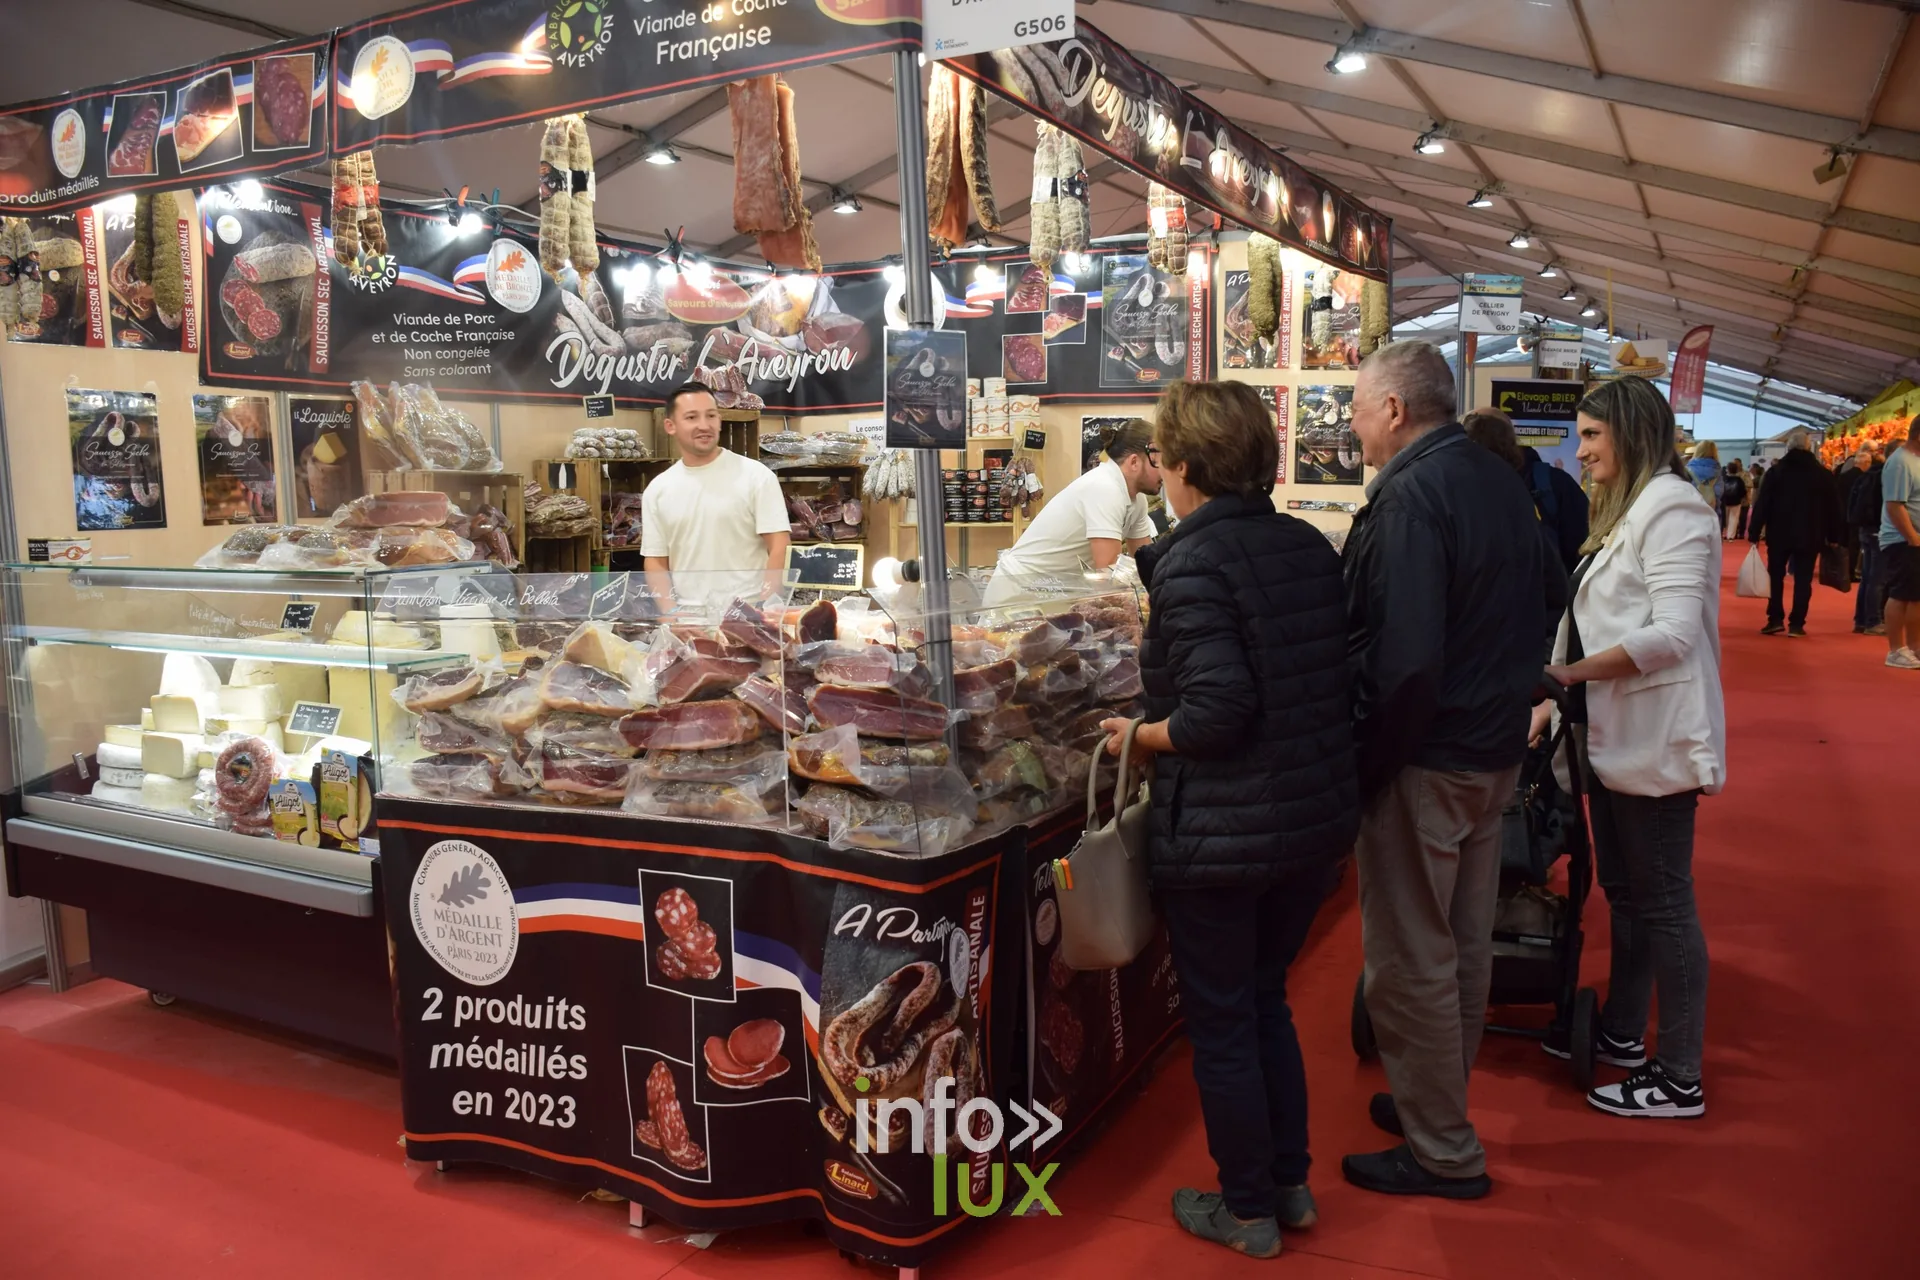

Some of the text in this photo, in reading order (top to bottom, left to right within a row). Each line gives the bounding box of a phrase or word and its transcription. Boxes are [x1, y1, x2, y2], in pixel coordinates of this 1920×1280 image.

[634, 12, 696, 36] Viande
[701, 4, 724, 24] de
[1014, 15, 1066, 37] G506
[556, 15, 614, 67] AVEYRON
[656, 24, 772, 65] Française
[1058, 38, 1180, 151] Déguster
[57, 175, 100, 197] médaillés
[106, 214, 118, 231] A
[179, 223, 191, 277] ARTISANALE
[83, 214, 104, 340] SAUCISSON SEC ARTISANAL
[349, 254, 397, 294] AVEYRON
[312, 215, 331, 365] SAUCISSON SEC ARTISANAL
[186, 307, 197, 349] SAUCISSE
[393, 313, 496, 326] Viande de Porc
[1482, 309, 1510, 317] REVIGNY
[371, 328, 515, 345] et de Coche Française
[1281, 335, 1290, 366] SAUCISSE
[404, 346, 491, 362] Non congelée
[545, 331, 683, 396] Déguster
[1192, 341, 1201, 381] SAUCISSE
[403, 363, 492, 377] Sans colorant
[1517, 392, 1576, 403] Elevage BRIER
[1522, 402, 1542, 413] Viande
[299, 407, 352, 429] Laguiole
[1541, 428, 1547, 436] ET
[247, 442, 261, 457] Sec
[1277, 391, 1288, 479] SAUCISSON SEC ARTISANAL
[826, 551, 838, 559] Sec
[384, 586, 441, 608] Jambon
[500, 592, 513, 606] de
[519, 584, 560, 606] Bellota
[417, 842, 509, 895] CONCOURS GÉNÉRAL AGRICOLE
[433, 906, 503, 930] MÉDAILLE
[834, 903, 871, 938] A
[436, 923, 503, 948] D'ARGENT
[420, 930, 429, 941] DE
[425, 940, 464, 977] L'AGRICULTURE
[464, 972, 471, 980] ET
[447, 942, 498, 965] PARIS 2023
[1161, 953, 1172, 973] de
[421, 987, 587, 1031] 2 produits
[1109, 967, 1124, 1062] SAUCISSON
[429, 1035, 588, 1080] médaillés
[452, 1087, 577, 1129] en 2023
[831, 1163, 869, 1192] Linard
